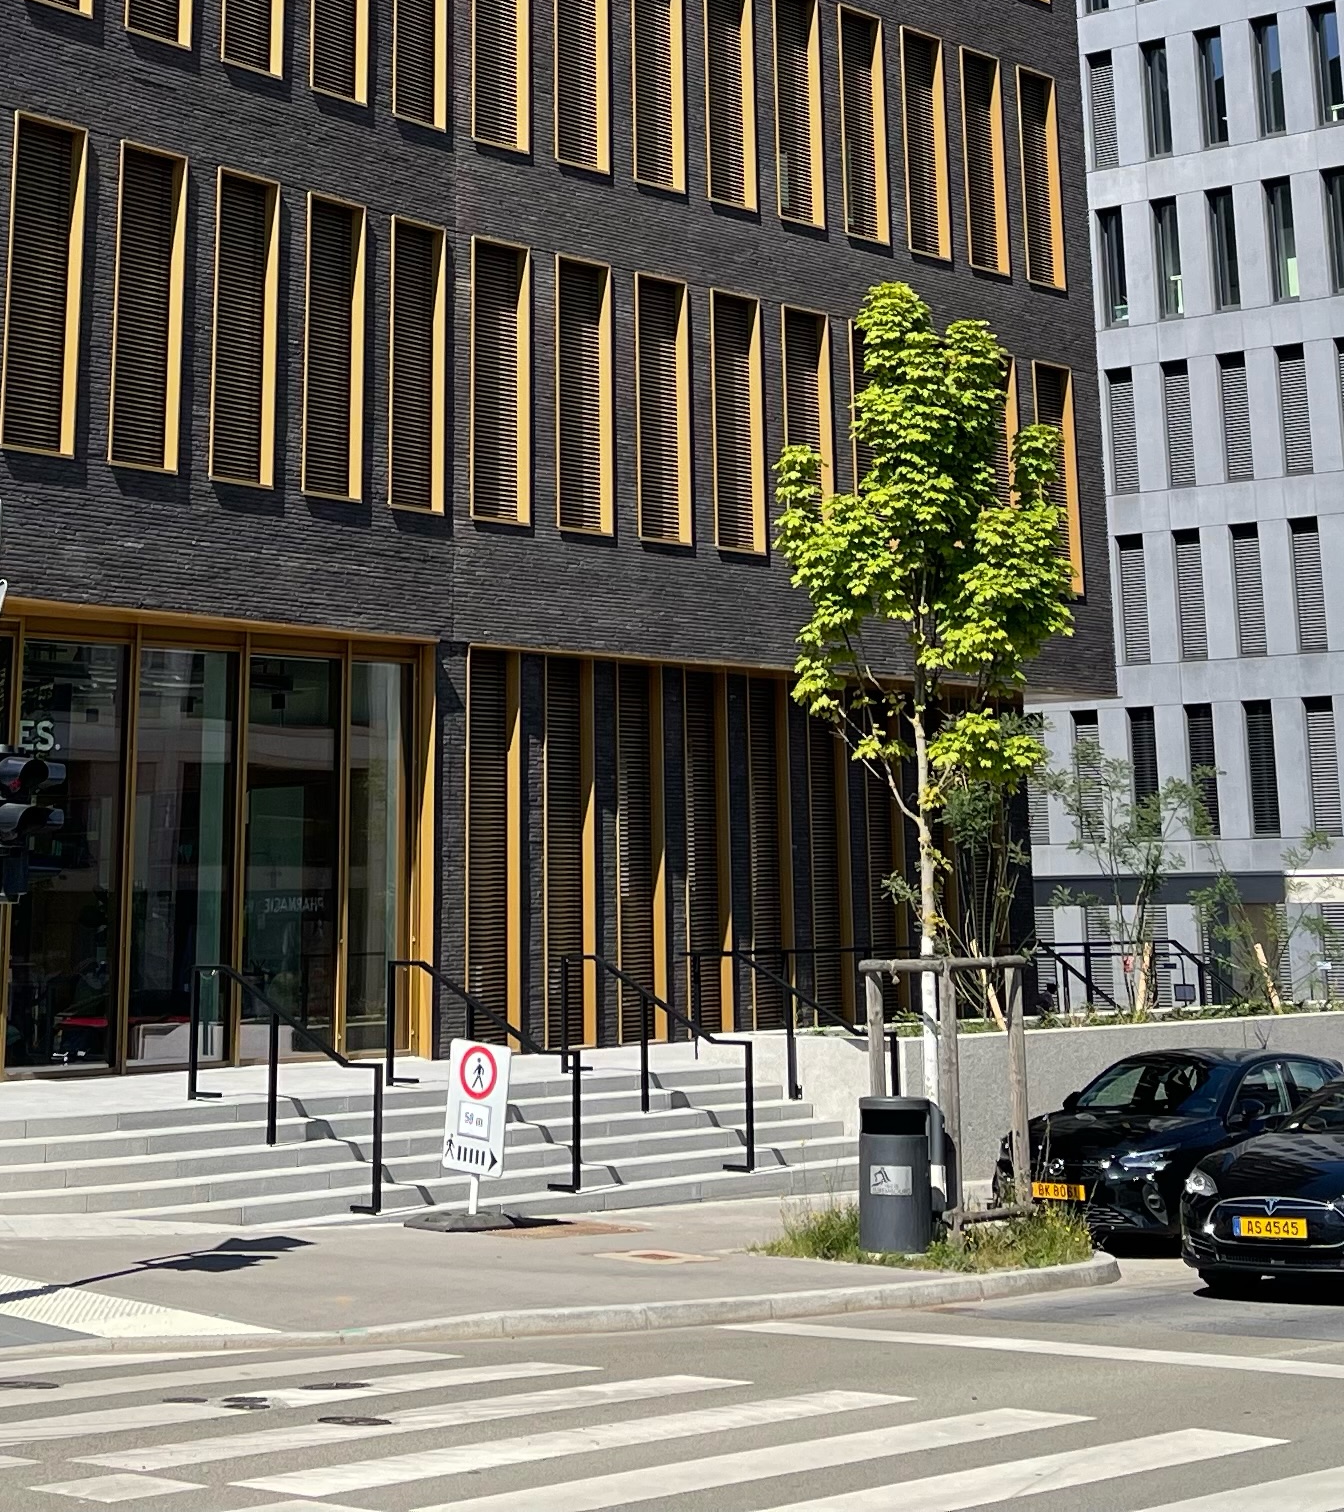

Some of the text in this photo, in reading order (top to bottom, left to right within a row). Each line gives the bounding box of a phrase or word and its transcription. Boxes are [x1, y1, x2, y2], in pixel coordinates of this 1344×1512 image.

[1037, 1183, 1051, 1197] BK
[1247, 1220, 1298, 1236] AS 4545
